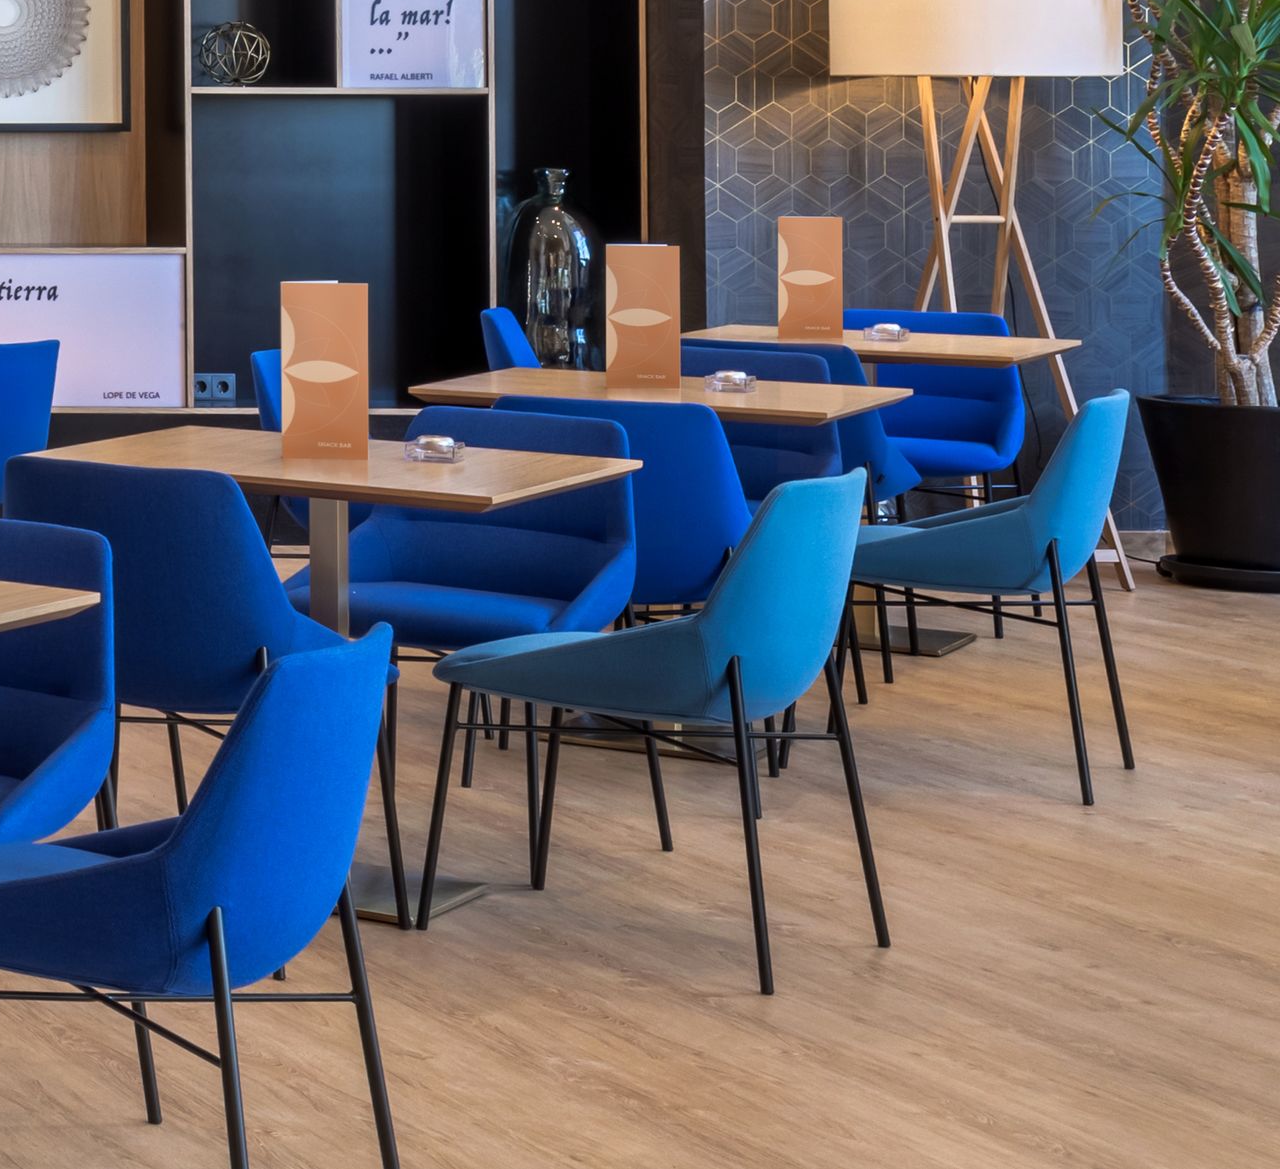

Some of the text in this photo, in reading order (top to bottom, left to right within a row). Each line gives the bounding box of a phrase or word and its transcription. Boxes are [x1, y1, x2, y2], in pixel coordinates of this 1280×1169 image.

[370, 0, 390, 25] la
[369, 72, 434, 81] RAFAEL ALBERTI
